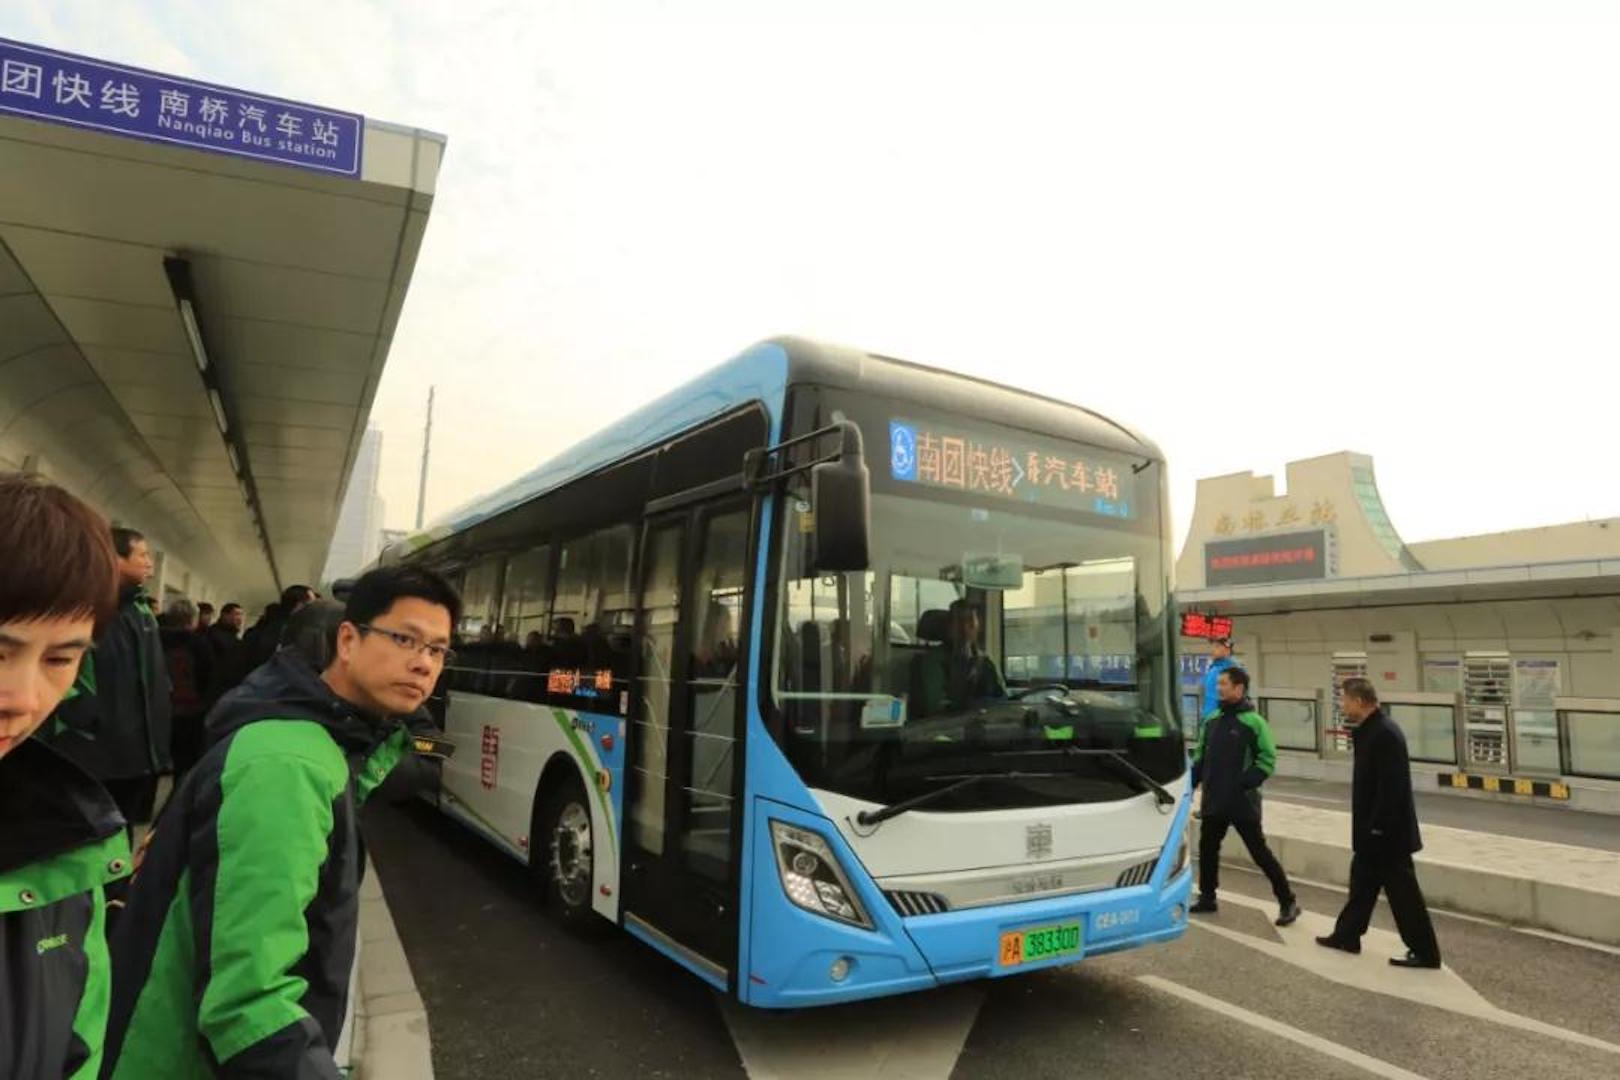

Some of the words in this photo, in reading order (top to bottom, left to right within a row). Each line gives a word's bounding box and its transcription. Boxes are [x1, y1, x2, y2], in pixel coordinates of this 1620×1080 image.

[1, 59, 141, 119] 团快线
[159, 88, 340, 147] 南桥汽车站
[157, 113, 235, 142] Nanqiao
[241, 130, 272, 148] Bus
[277, 139, 337, 160] station
